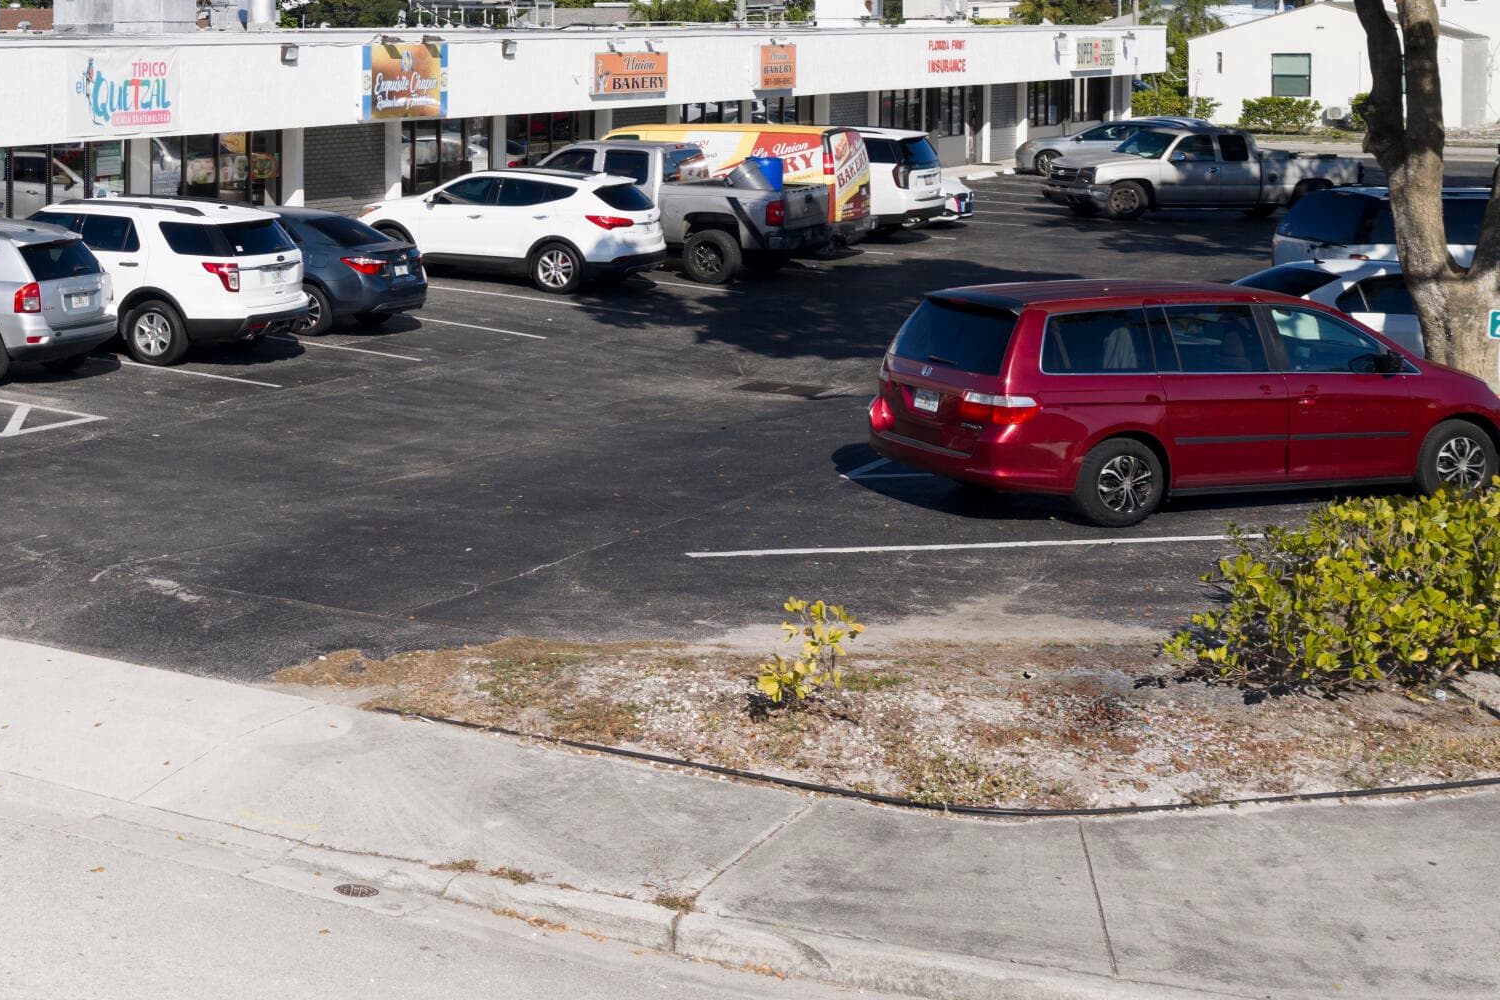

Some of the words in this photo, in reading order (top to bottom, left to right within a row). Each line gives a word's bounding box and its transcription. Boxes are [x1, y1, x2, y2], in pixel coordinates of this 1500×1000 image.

[131, 58, 167, 78] TÍPICO
[763, 64, 794, 75] BAKERY
[927, 58, 966, 73] INSURANCE
[611, 75, 666, 91] BAKERY
[772, 141, 809, 156] Union
